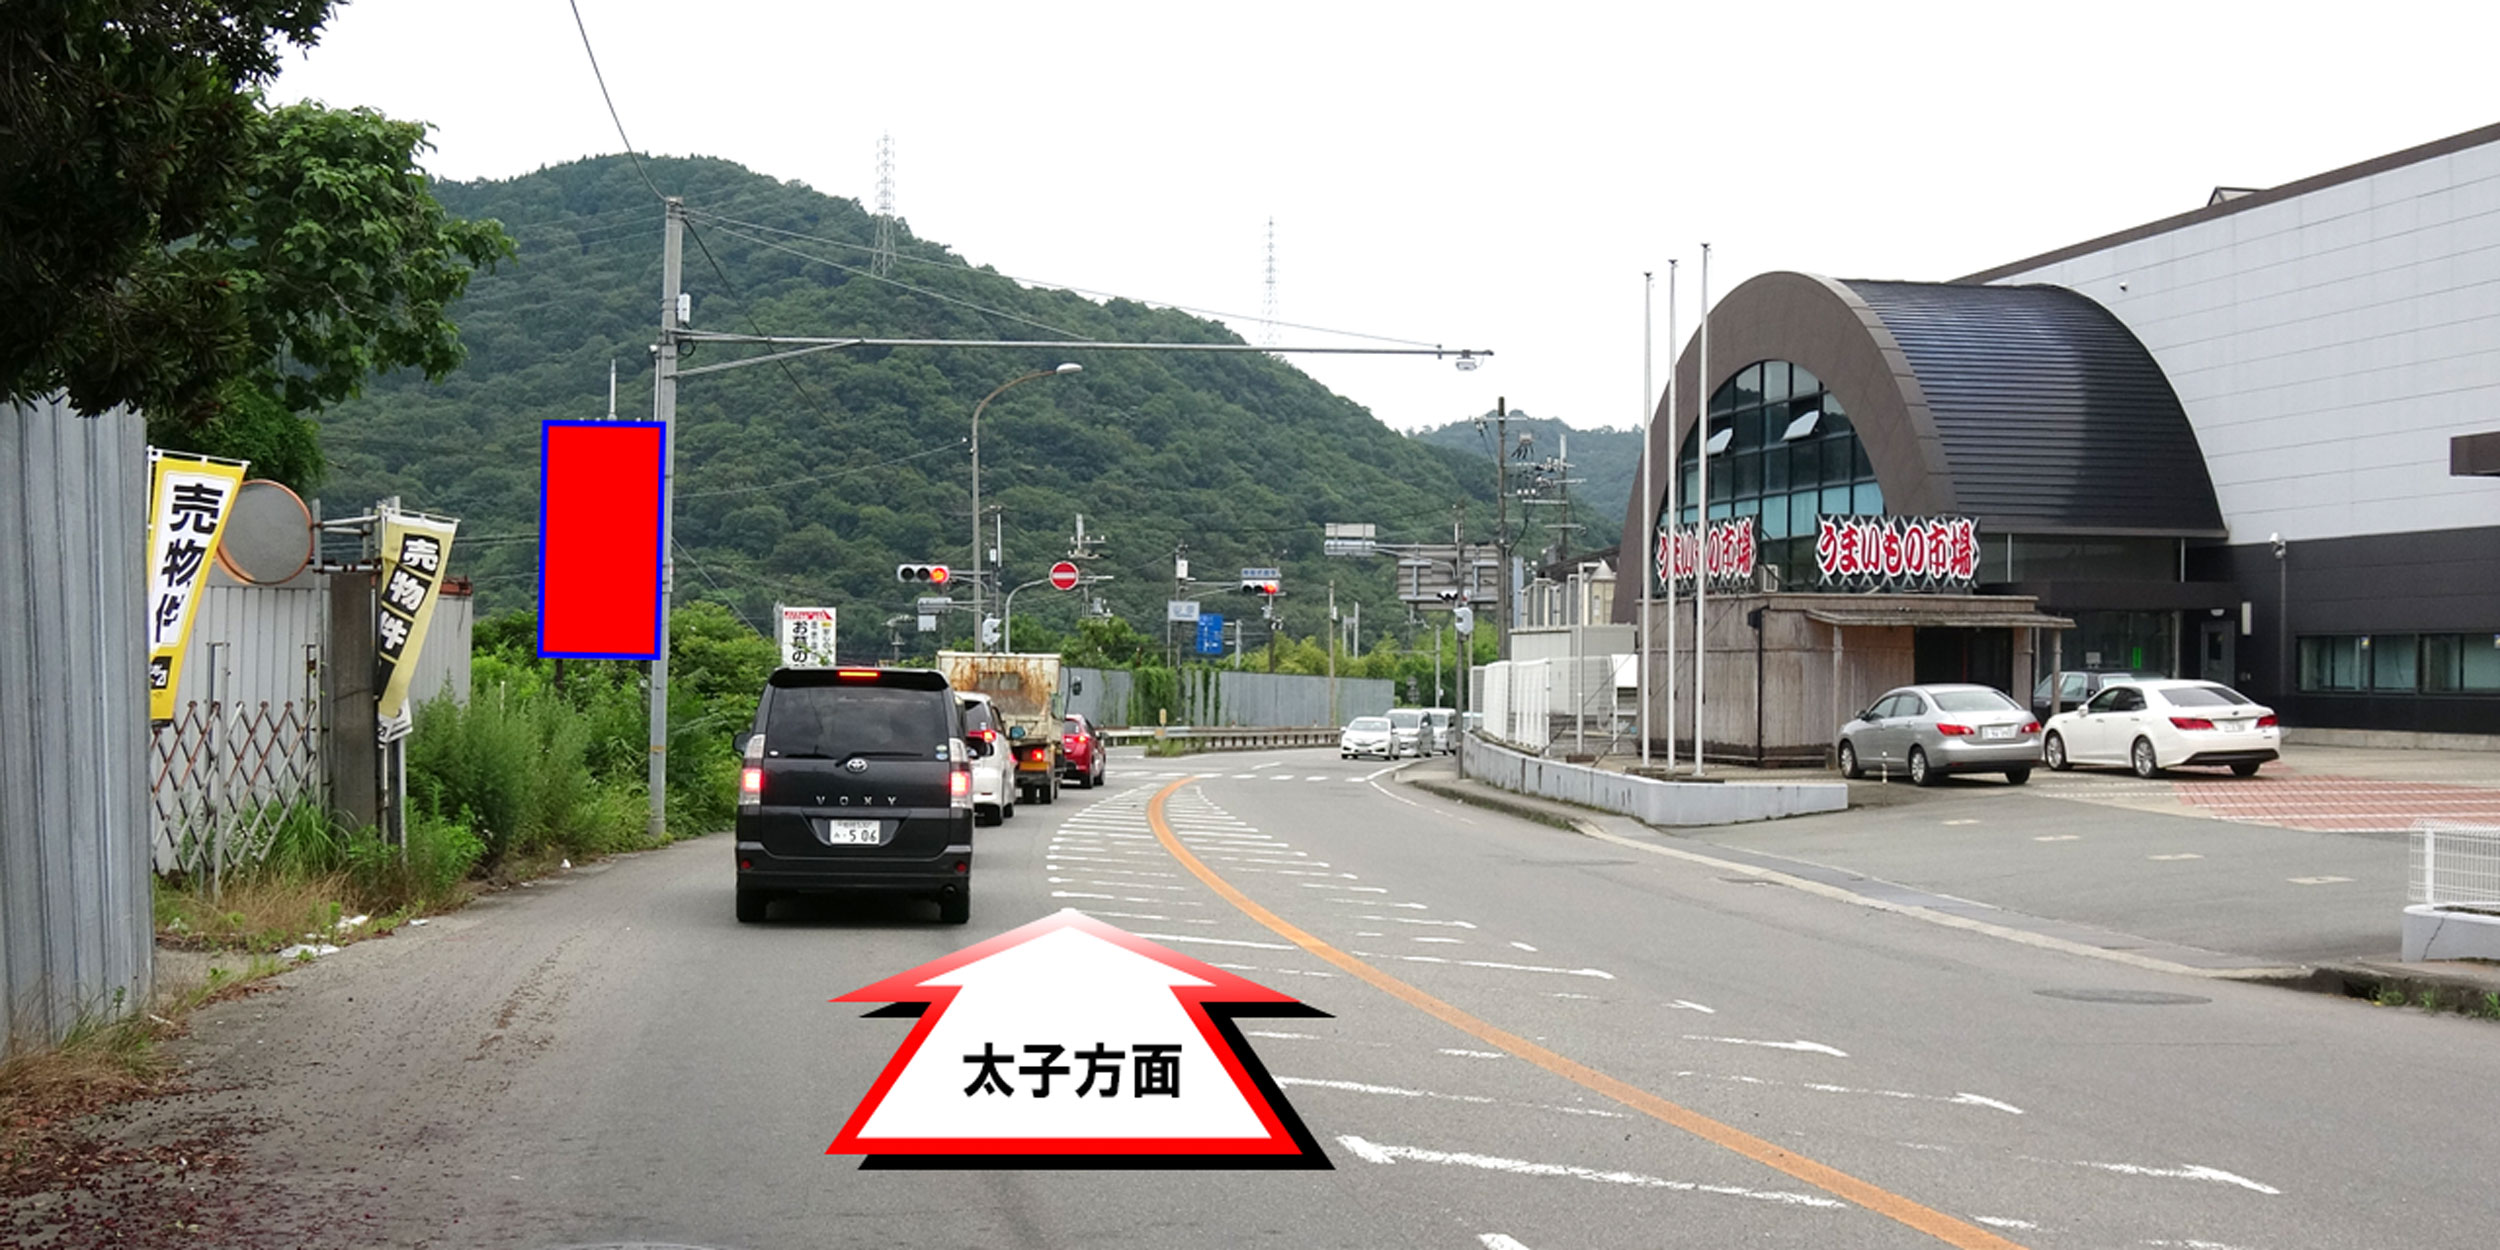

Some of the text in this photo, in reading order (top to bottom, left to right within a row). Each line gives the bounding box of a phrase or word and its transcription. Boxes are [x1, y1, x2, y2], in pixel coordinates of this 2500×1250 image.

[1817, 519, 1978, 578] うまいもの市場
[380, 538, 440, 650] 売物件
[815, 795, 897, 806] VOXY
